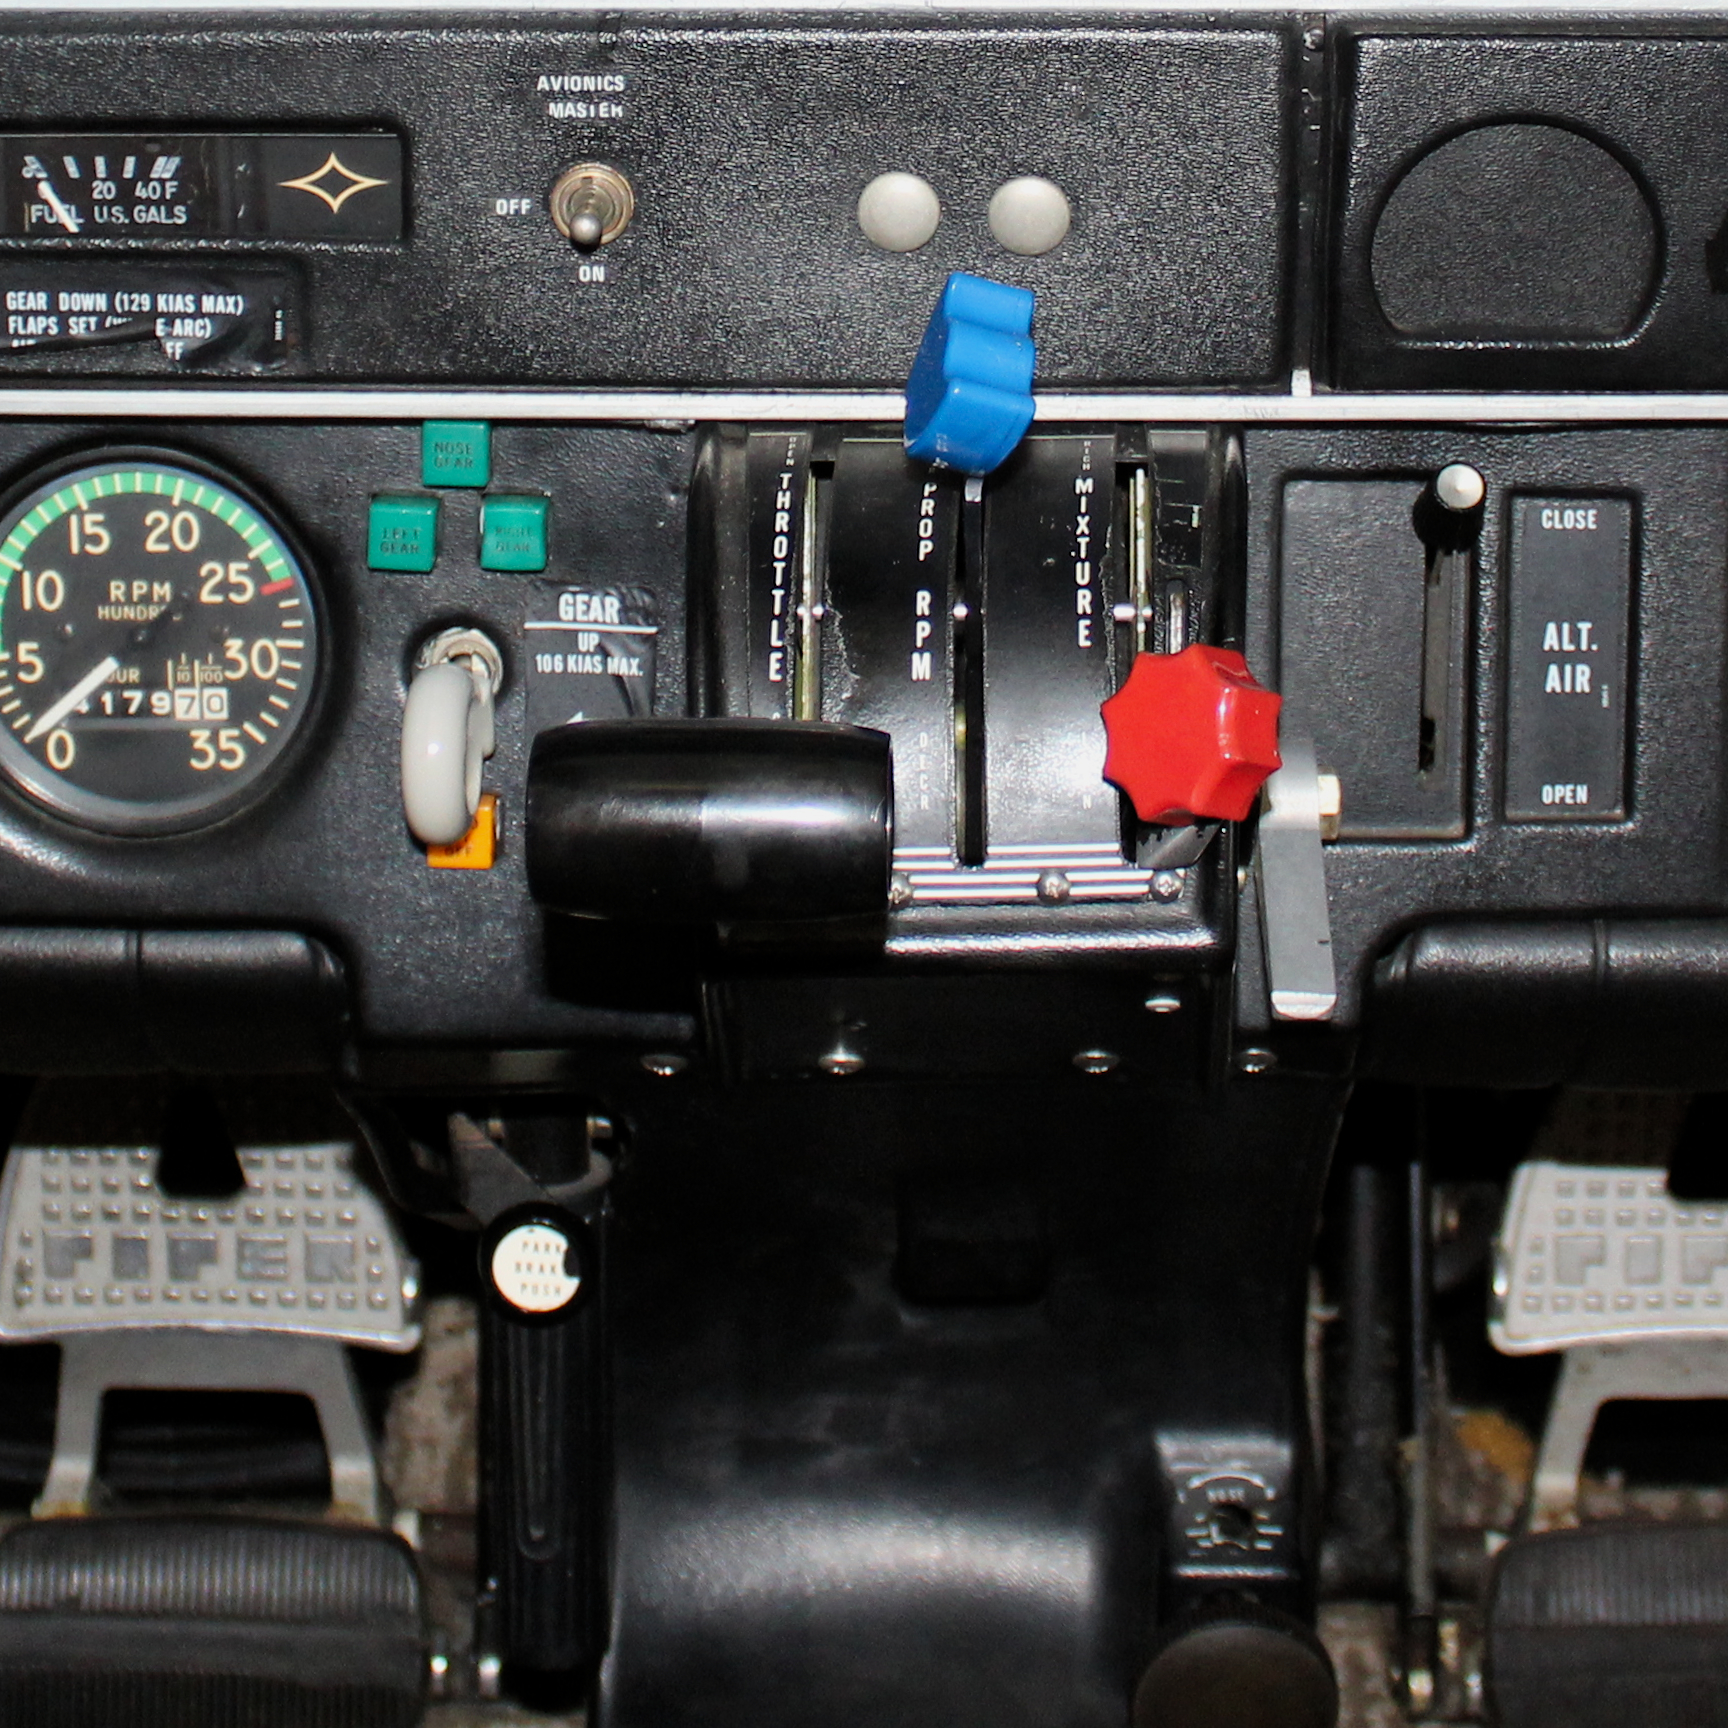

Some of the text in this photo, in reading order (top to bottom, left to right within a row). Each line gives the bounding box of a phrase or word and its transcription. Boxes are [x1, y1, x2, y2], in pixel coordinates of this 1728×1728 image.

[537, 75, 625, 92] AVIONICS
[496, 198, 530, 215] OFF
[579, 265, 605, 283] ON
[6, 291, 244, 317] GEAR DOWN (129 KIAS MAX)
[145, 512, 200, 552] 20
[1541, 509, 1597, 530] CLOSE
[1076, 477, 1094, 648] MIXTURE
[199, 563, 255, 604] 25
[768, 473, 791, 681] THROTTLE
[109, 579, 171, 603] RPM
[559, 593, 619, 625] GEAR
[577, 632, 598, 653] UP
[1543, 622, 1598, 653] ALT.
[535, 653, 643, 677] 106 KIAS MAX.
[1545, 663, 1591, 695] AIR
[1541, 783, 1588, 805] OPEN
